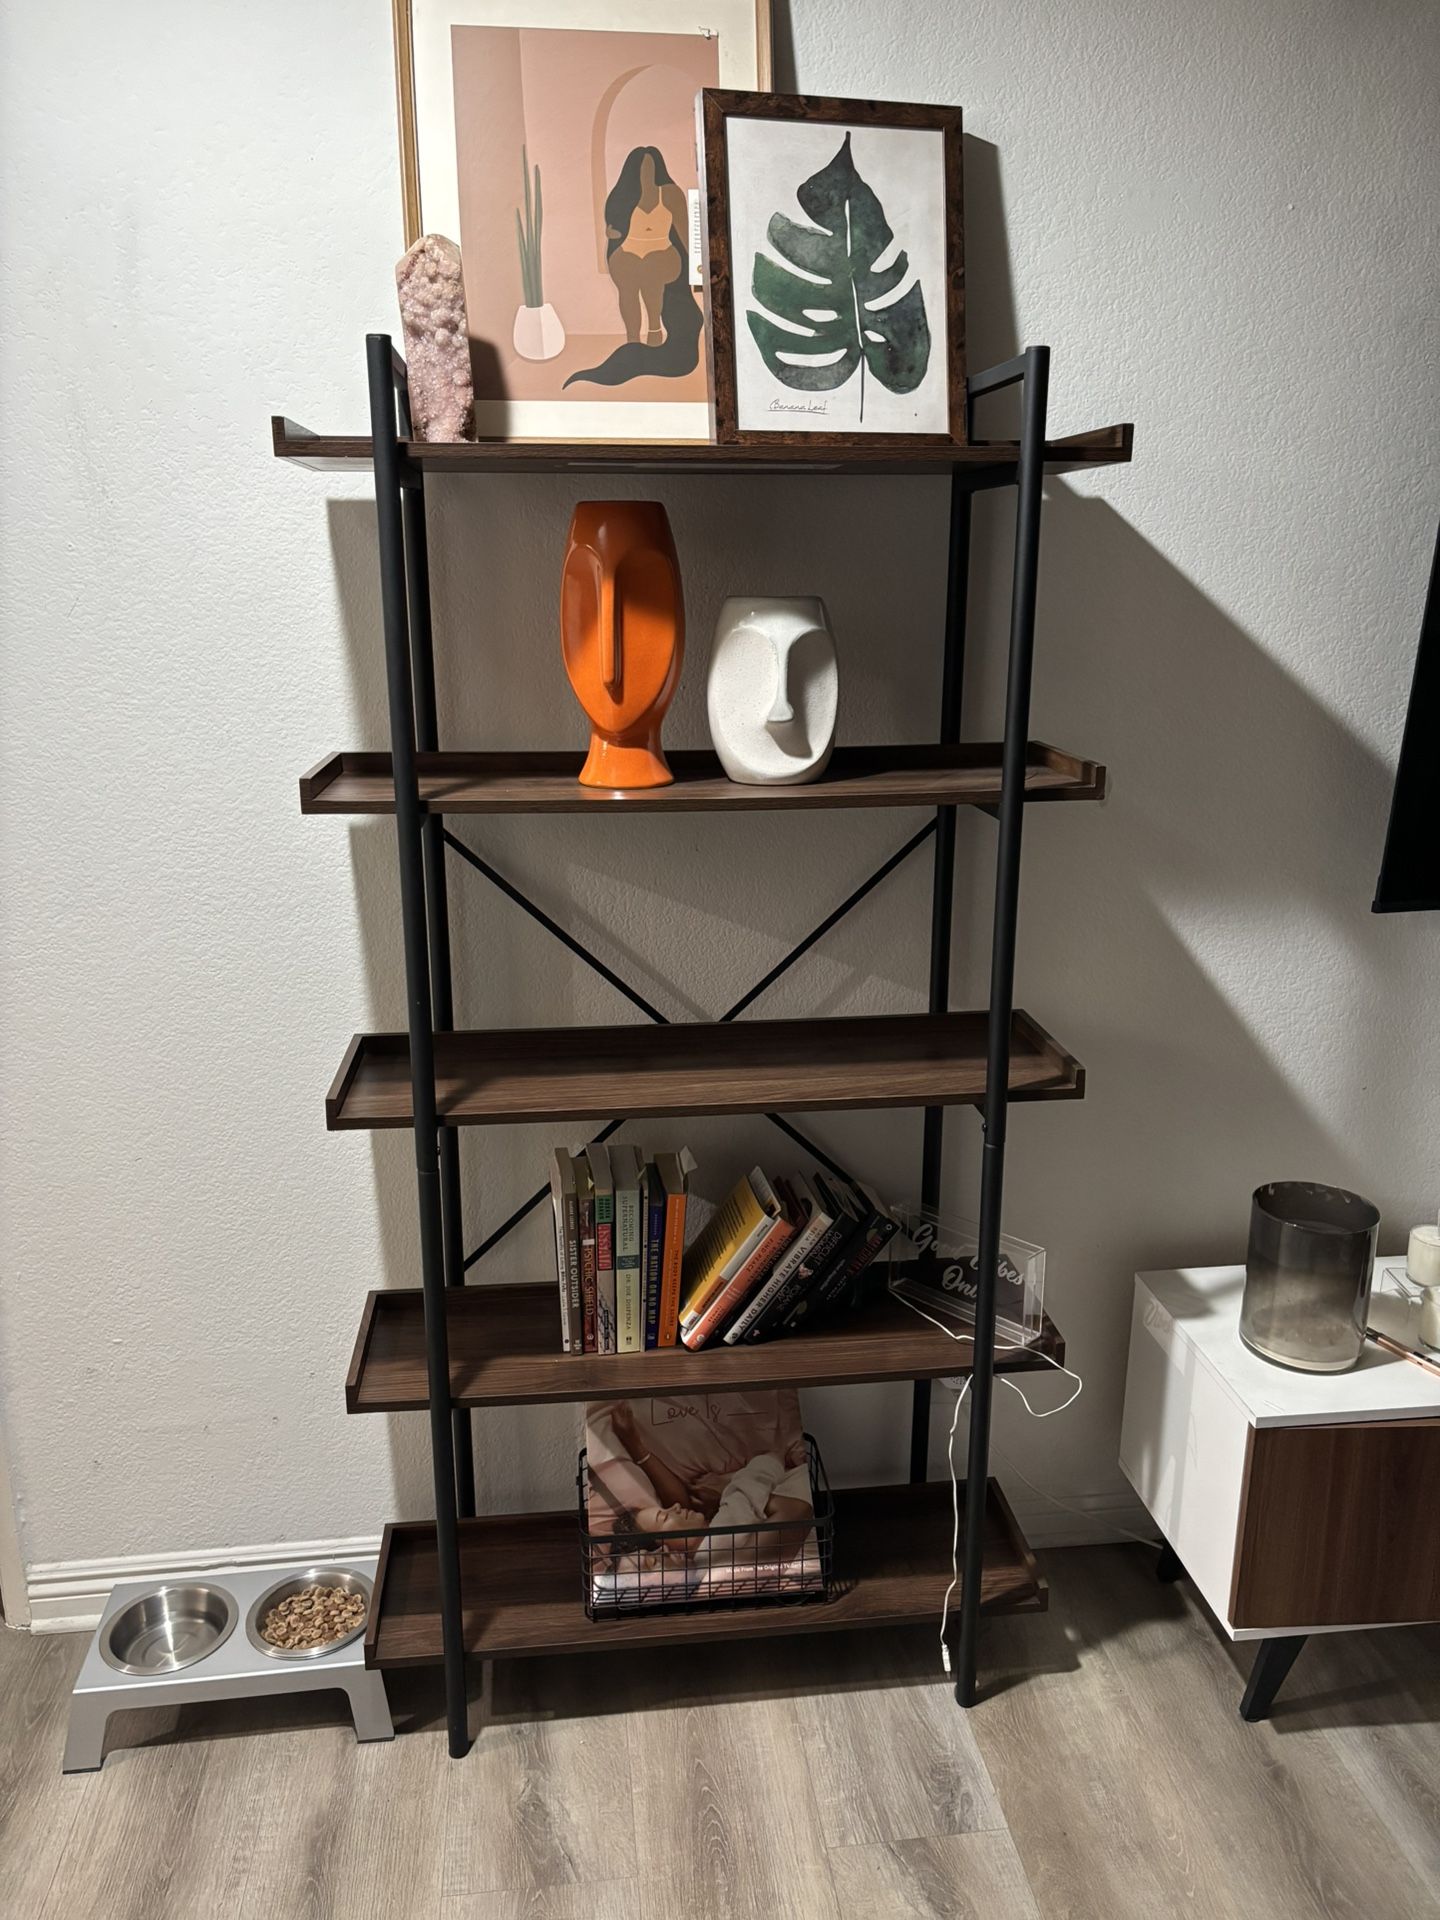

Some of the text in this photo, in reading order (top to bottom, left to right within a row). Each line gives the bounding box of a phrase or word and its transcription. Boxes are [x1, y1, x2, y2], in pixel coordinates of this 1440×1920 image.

[768, 399, 807, 411] Banana
[598, 1225, 611, 1269] ASSATA
[650, 1240, 659, 1251] THE
[649, 1256, 658, 1281] NATION
[745, 1253, 762, 1272] PEACE
[778, 1244, 807, 1279] VIBRATE
[569, 1240, 580, 1309] SISTER OUTSIDER
[583, 1248, 594, 1315] PSYCHIC SHIELD
[942, 1265, 978, 1298] Onl
[648, 1297, 656, 1306] NO
[649, 1285, 657, 1293] ON
[754, 1277, 781, 1309] HIGHER
[647, 1309, 656, 1324] MAP
[737, 1307, 757, 1331] DAILY
[651, 1398, 699, 1425] Love
